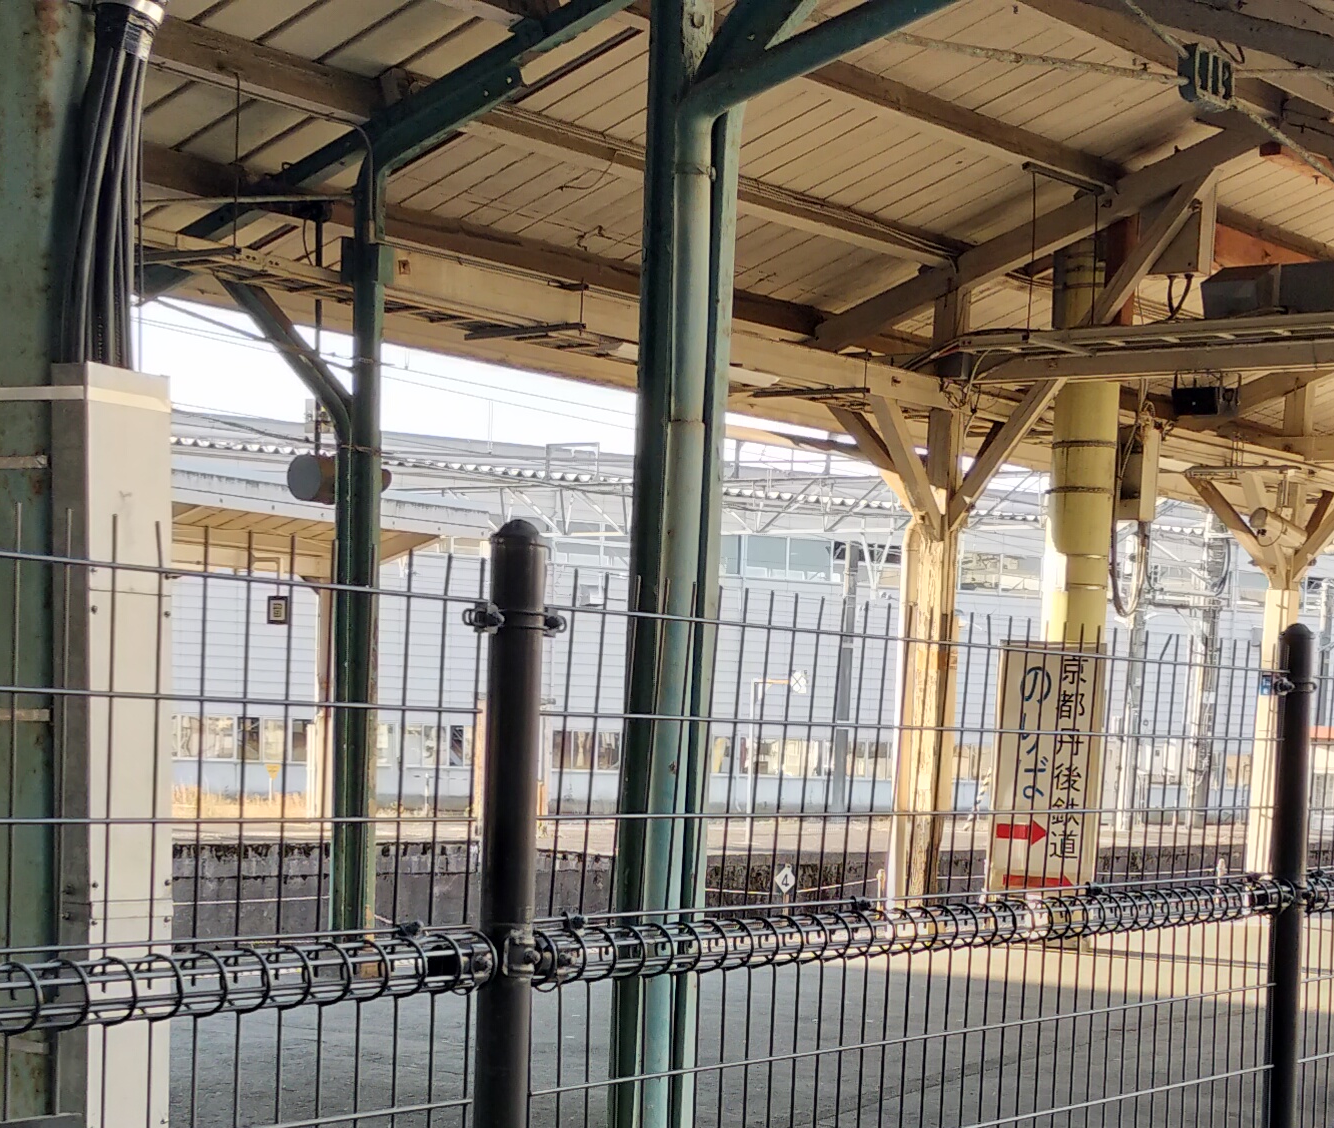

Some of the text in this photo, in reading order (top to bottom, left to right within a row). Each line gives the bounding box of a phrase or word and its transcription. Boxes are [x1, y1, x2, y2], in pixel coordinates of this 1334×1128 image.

[1019, 665, 1053, 801] のりば
[1049, 656, 1089, 860] 京都丹後鉄道
[781, 873, 790, 887] 4
